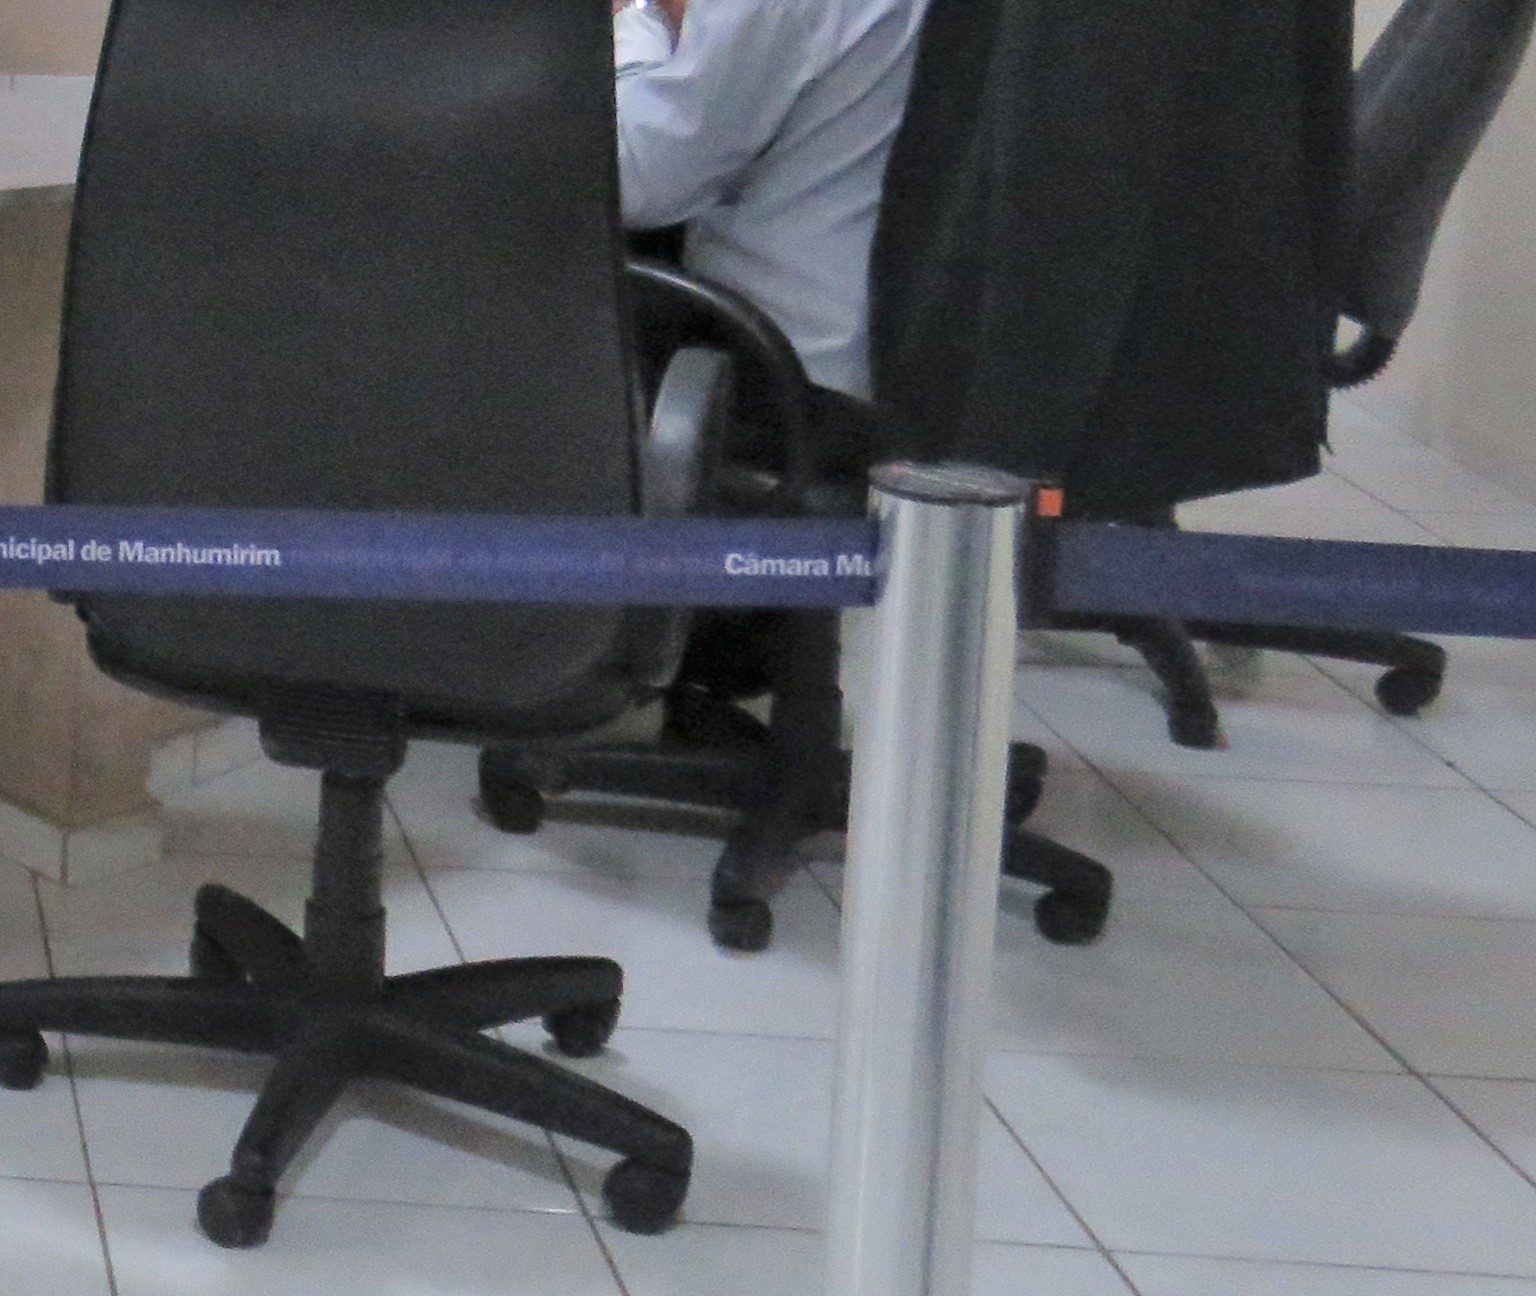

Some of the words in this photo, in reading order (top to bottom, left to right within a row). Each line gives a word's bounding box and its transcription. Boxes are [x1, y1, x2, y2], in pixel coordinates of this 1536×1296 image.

[81, 540, 112, 563] de
[118, 540, 281, 566] Manhumirim
[724, 552, 828, 576] Câmara
